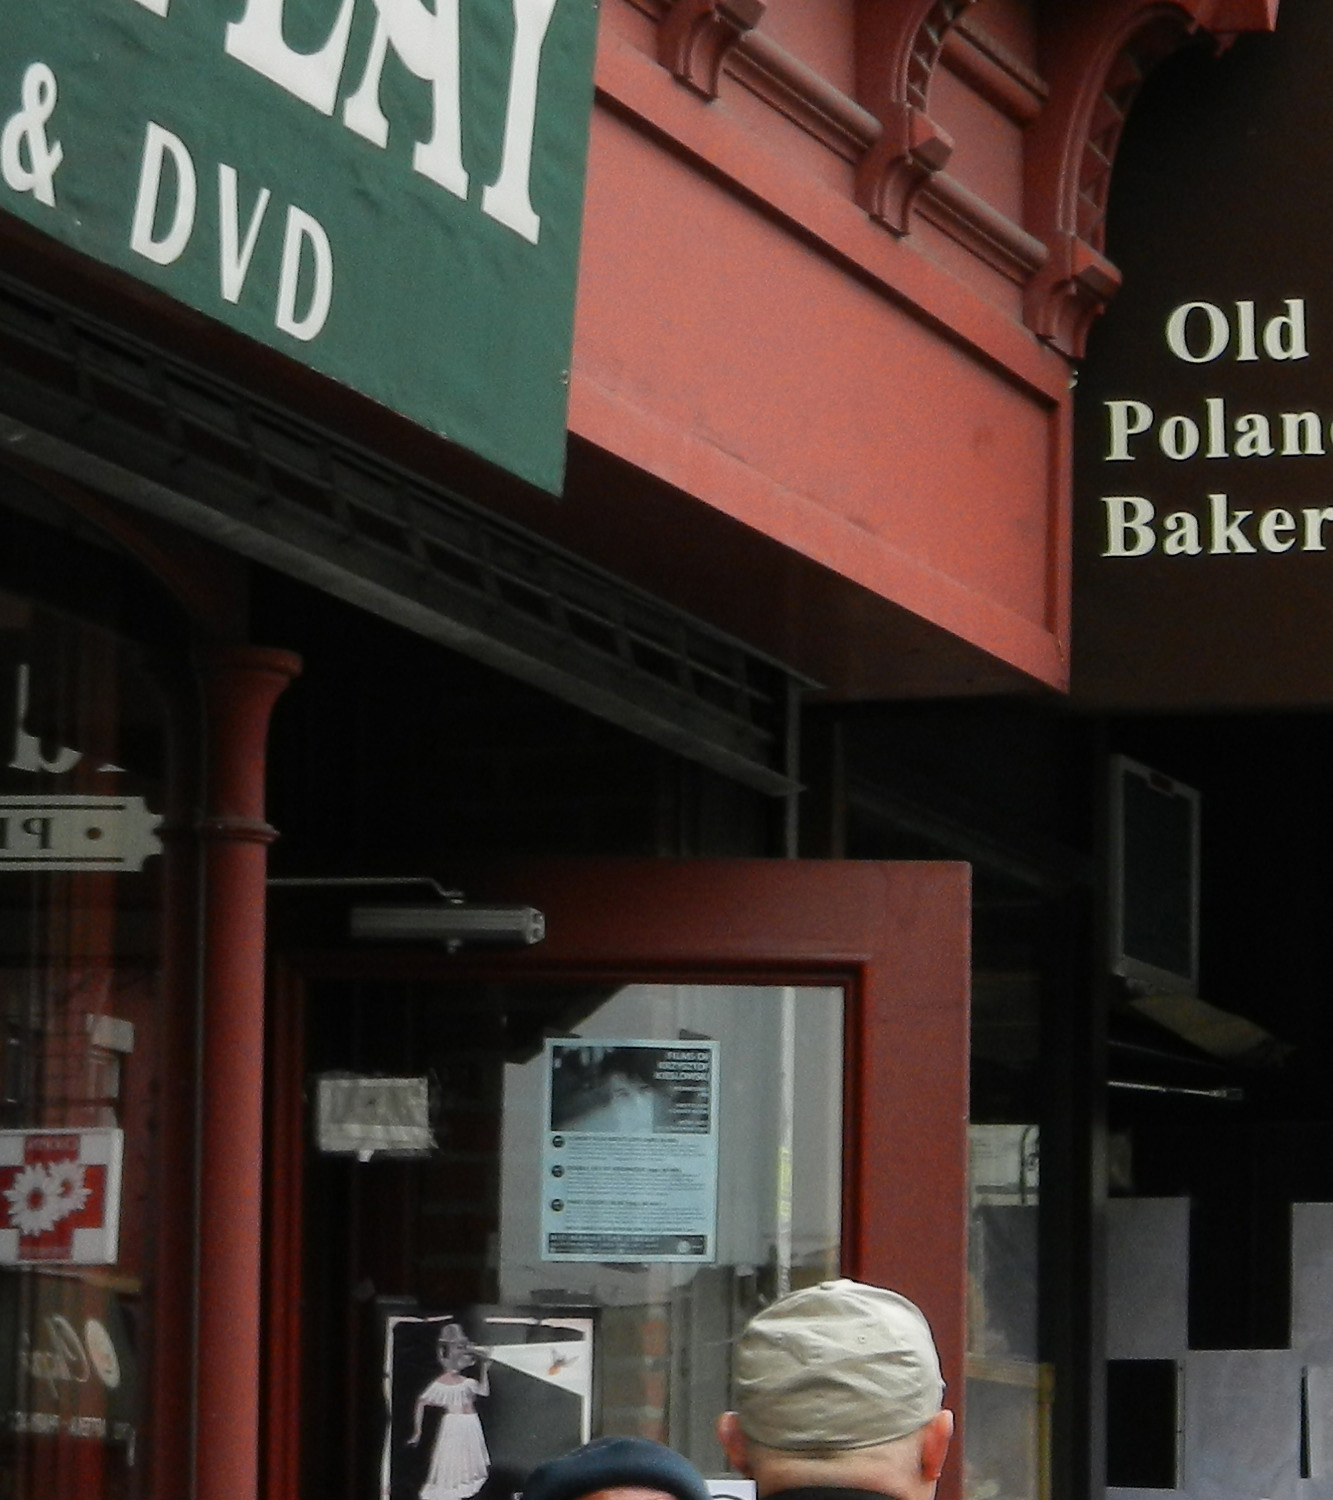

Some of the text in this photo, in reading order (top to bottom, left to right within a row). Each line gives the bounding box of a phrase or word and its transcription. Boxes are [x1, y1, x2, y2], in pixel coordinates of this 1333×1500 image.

[0, 61, 335, 343] & DVD
[1165, 297, 1310, 364] Old
